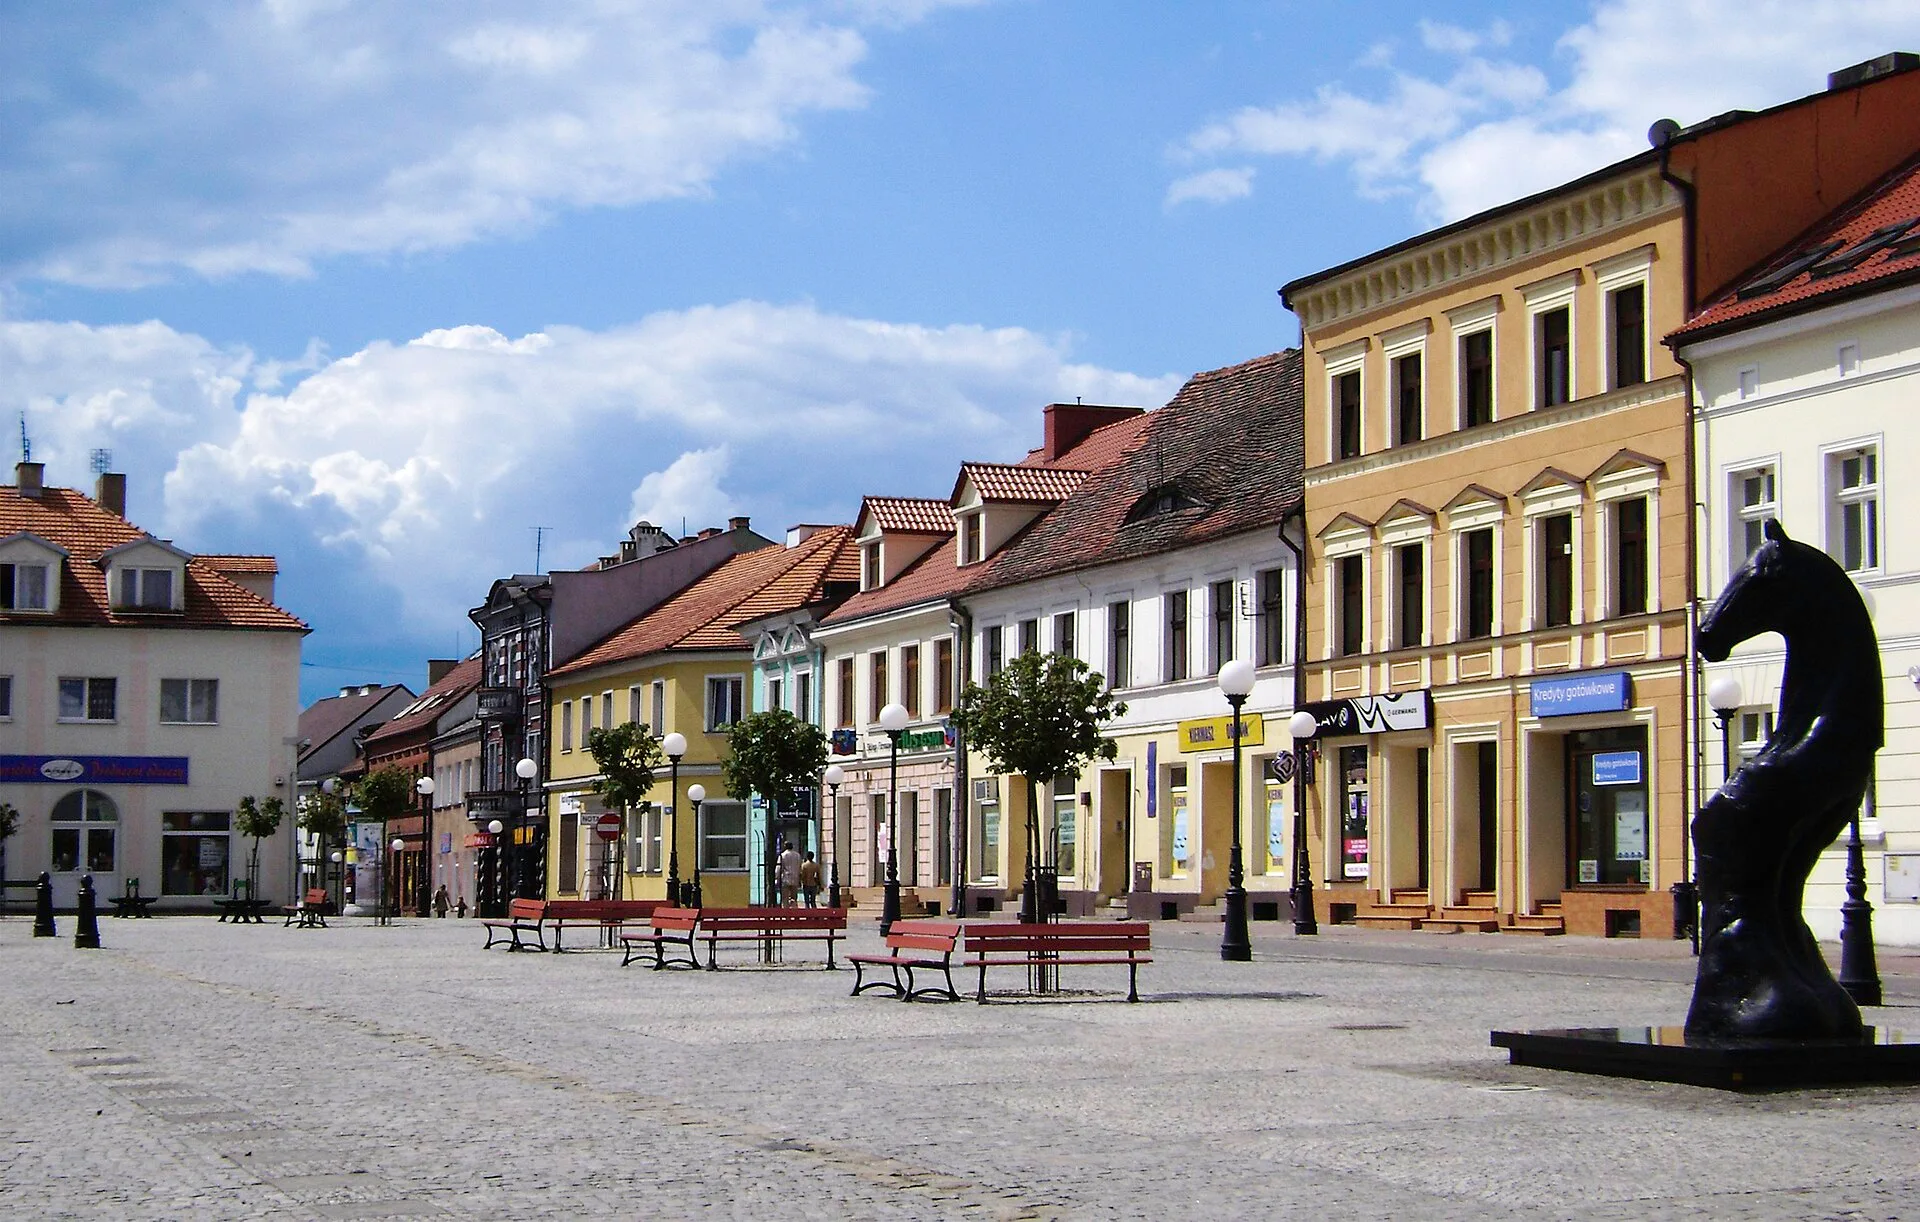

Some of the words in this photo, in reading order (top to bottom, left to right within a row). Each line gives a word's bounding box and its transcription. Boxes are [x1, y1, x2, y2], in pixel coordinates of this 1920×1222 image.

[1534, 687, 1565, 702] Kredyty
[1566, 682, 1615, 701] gotówkowe
[1391, 707, 1418, 716] GERMANOS
